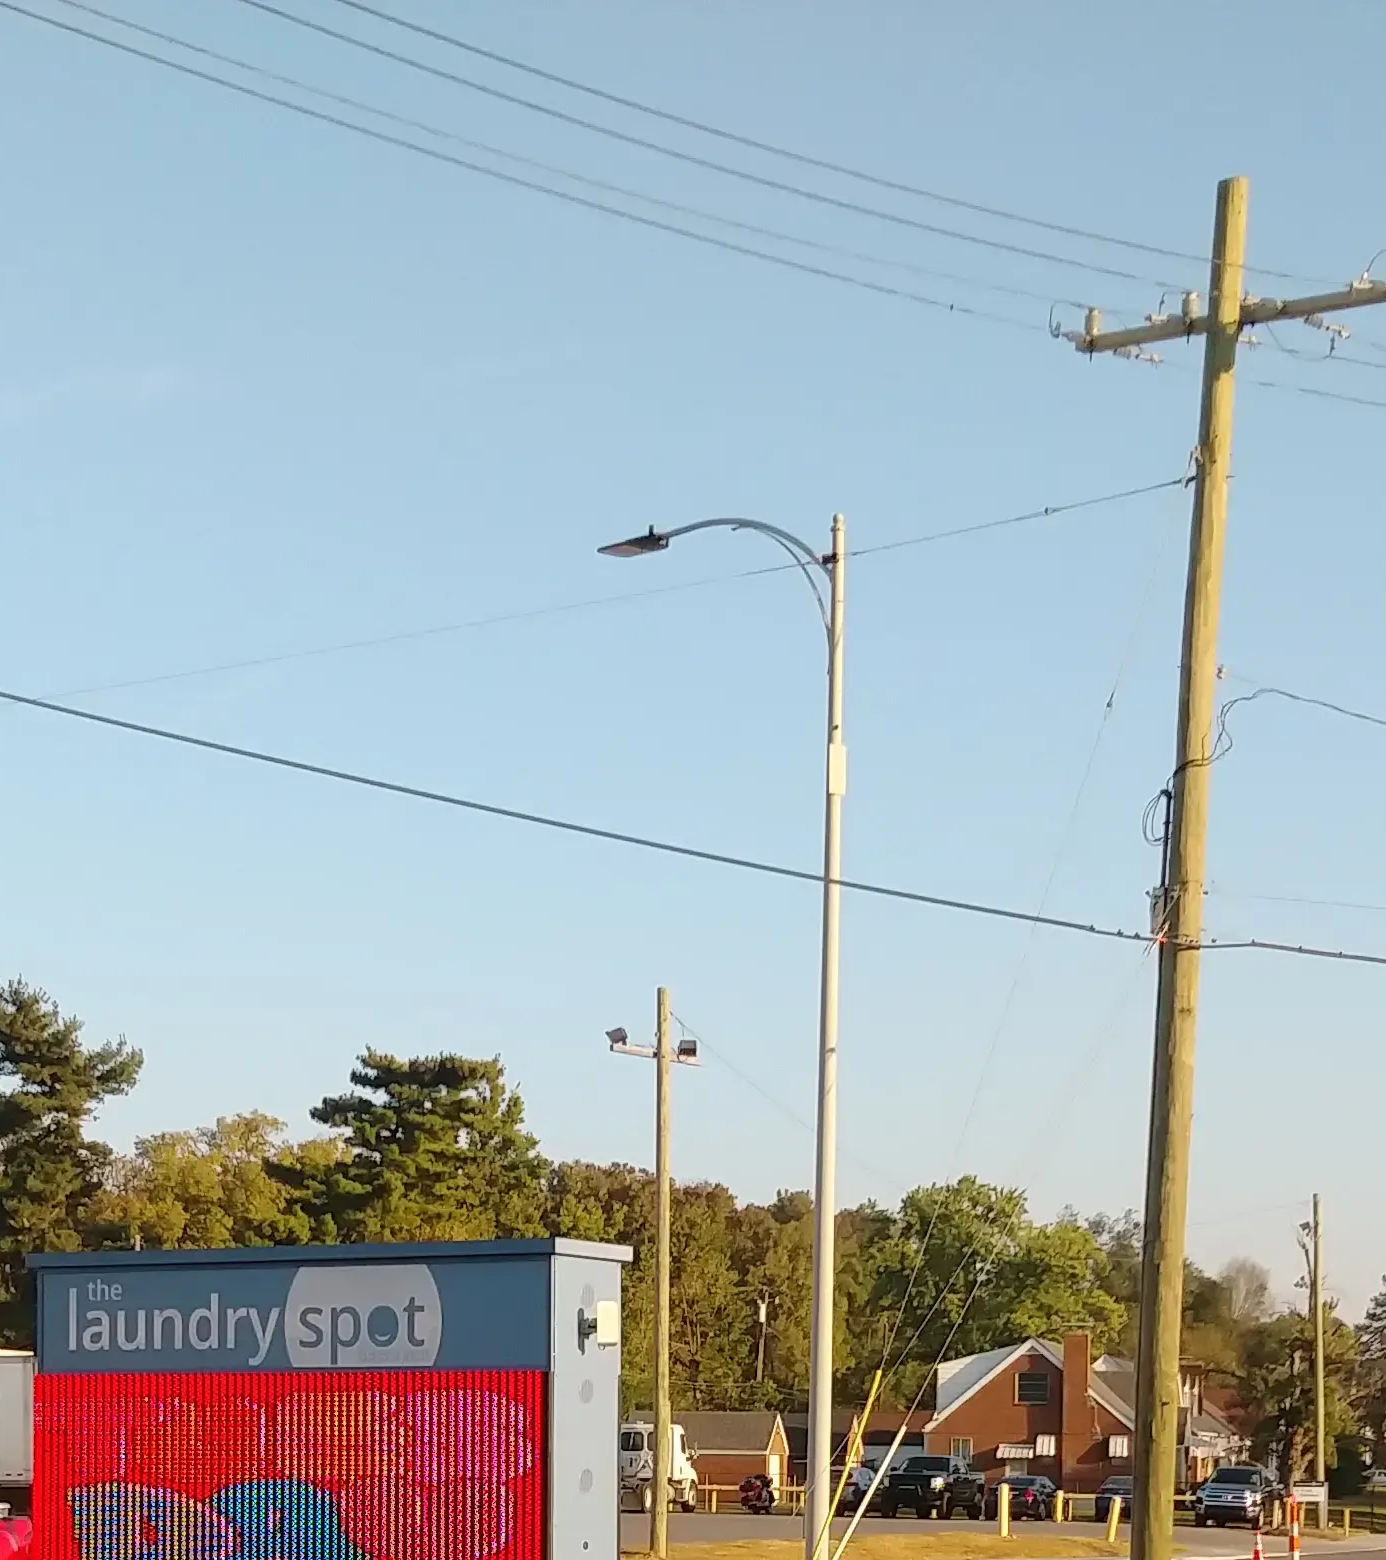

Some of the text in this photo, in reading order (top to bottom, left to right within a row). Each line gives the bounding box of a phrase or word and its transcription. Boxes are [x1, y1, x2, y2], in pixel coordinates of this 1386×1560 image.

[88, 1279, 123, 1301] the
[68, 1288, 426, 1367] laundry spot
